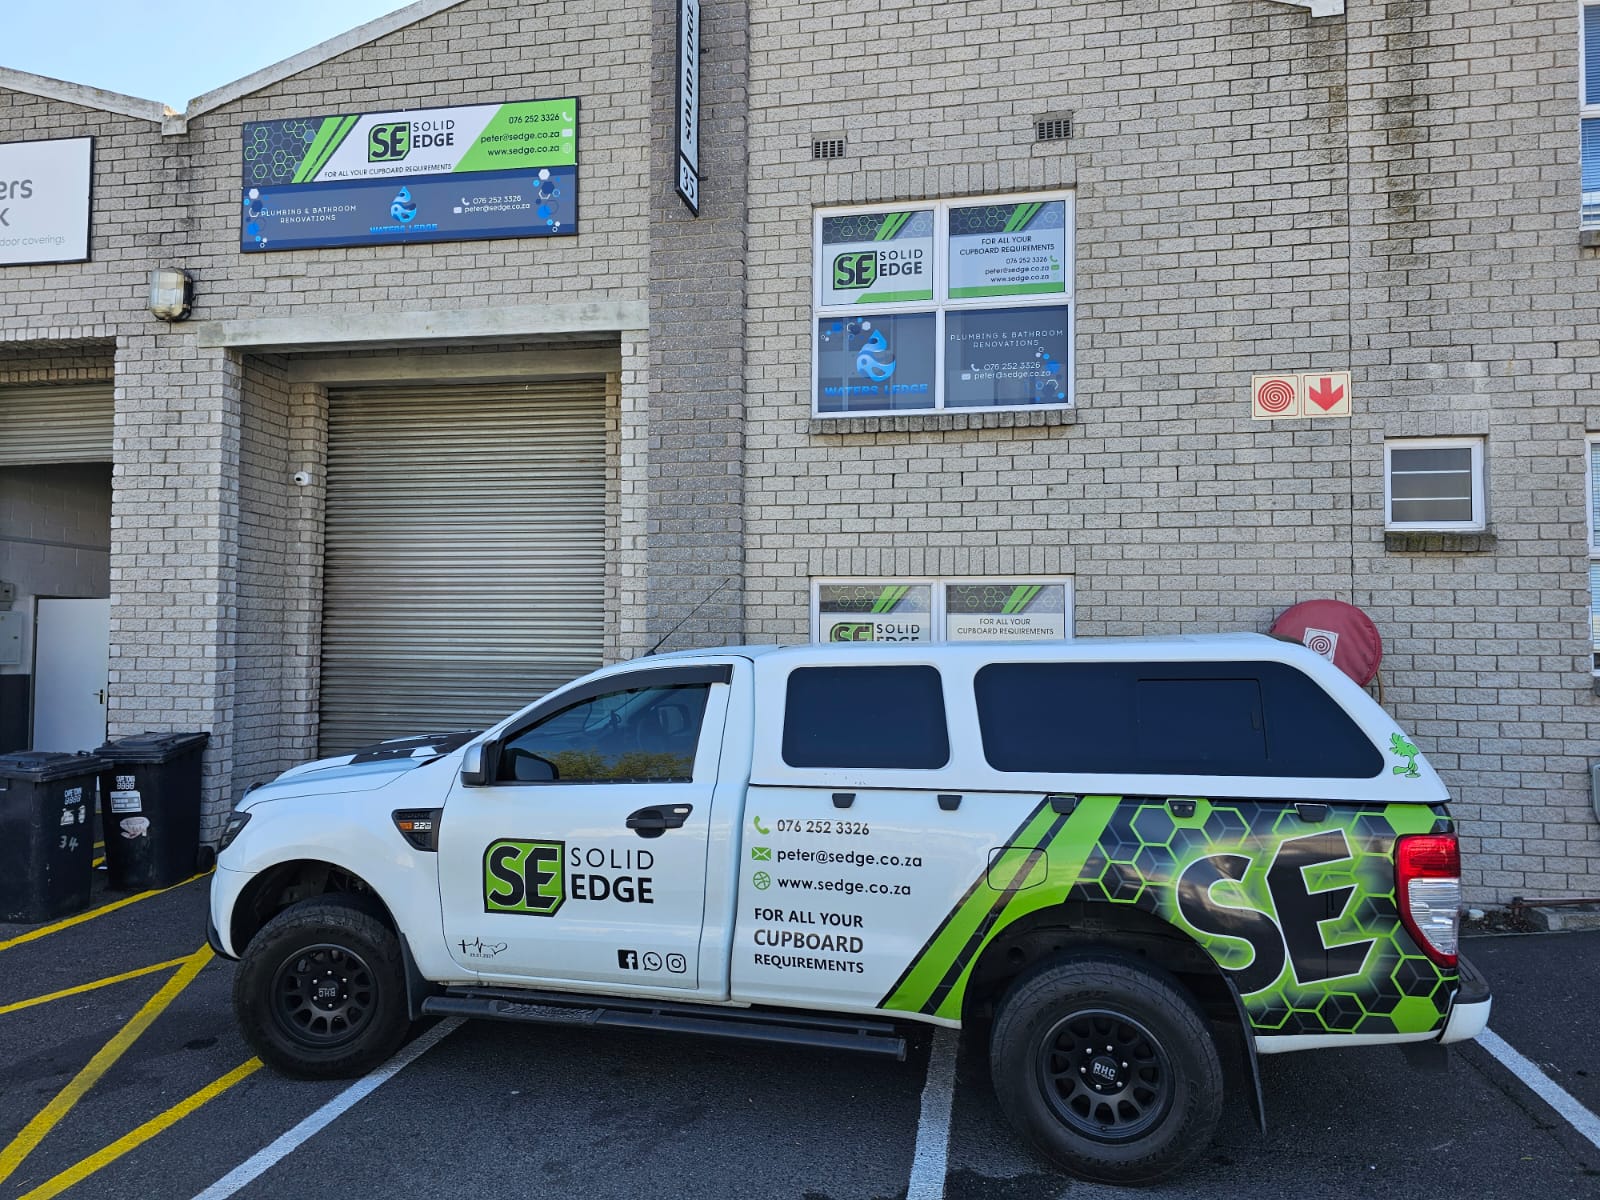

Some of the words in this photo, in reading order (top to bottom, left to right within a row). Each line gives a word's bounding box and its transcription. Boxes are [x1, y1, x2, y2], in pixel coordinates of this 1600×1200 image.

[684, 68, 693, 144] SOLID
[508, 116, 522, 124] 076
[525, 115, 539, 123] 252
[541, 113, 560, 122] 3326
[412, 120, 455, 132] SOLID
[371, 126, 407, 158] SE
[412, 133, 454, 148] EDGE
[480, 131, 560, 144] peter@sedge.co.za
[487, 145, 560, 156] www.sedge.co.za
[368, 167, 403, 175] CUPBOARD
[405, 163, 452, 173] REQUIREMENTS
[472, 197, 487, 205] 076
[261, 208, 302, 217] PLUMBING
[312, 205, 357, 214] BATHROOM
[464, 203, 531, 214] peter@sedge.co.za
[280, 214, 336, 224] RENOVATIONS
[1012, 235, 1032, 243] YOUR
[879, 248, 924, 261] SOLID
[959, 247, 1000, 256] CUPBOARD
[1001, 243, 1055, 253] REQUIREMENTS
[1006, 257, 1018, 265] 076
[836, 253, 873, 287] SE
[879, 261, 923, 277] EDGE
[990, 274, 1049, 283] www.sedge.co.za
[950, 333, 998, 341] PLUMBING
[1011, 330, 1064, 338] BATHROOM
[973, 339, 1039, 348] RENOVATIONS
[983, 363, 1000, 371] 076
[1002, 362, 1018, 370] 252
[1019, 361, 1041, 369] 3326
[974, 370, 1051, 380] peter@sedge.co.za
[876, 623, 921, 634] SOLID
[957, 627, 998, 635] CUPBOARD
[777, 819, 801, 833] 076
[806, 820, 831, 834] 252
[835, 822, 870, 836] 3326
[570, 847, 654, 870] SOLID
[777, 849, 922, 867] peter@sedge.co.za
[488, 845, 559, 909] SE
[571, 874, 654, 904] EDGE
[777, 878, 911, 895] www.sedge.co.za
[754, 908, 784, 922] FOR
[789, 910, 815, 924] ALL
[820, 912, 864, 928] YOUR
[1176, 828, 1378, 997] SE
[754, 929, 864, 953] CUPBOARD
[754, 954, 864, 973] REQUIREMENTS
[1093, 1062, 1116, 1077] RHC
